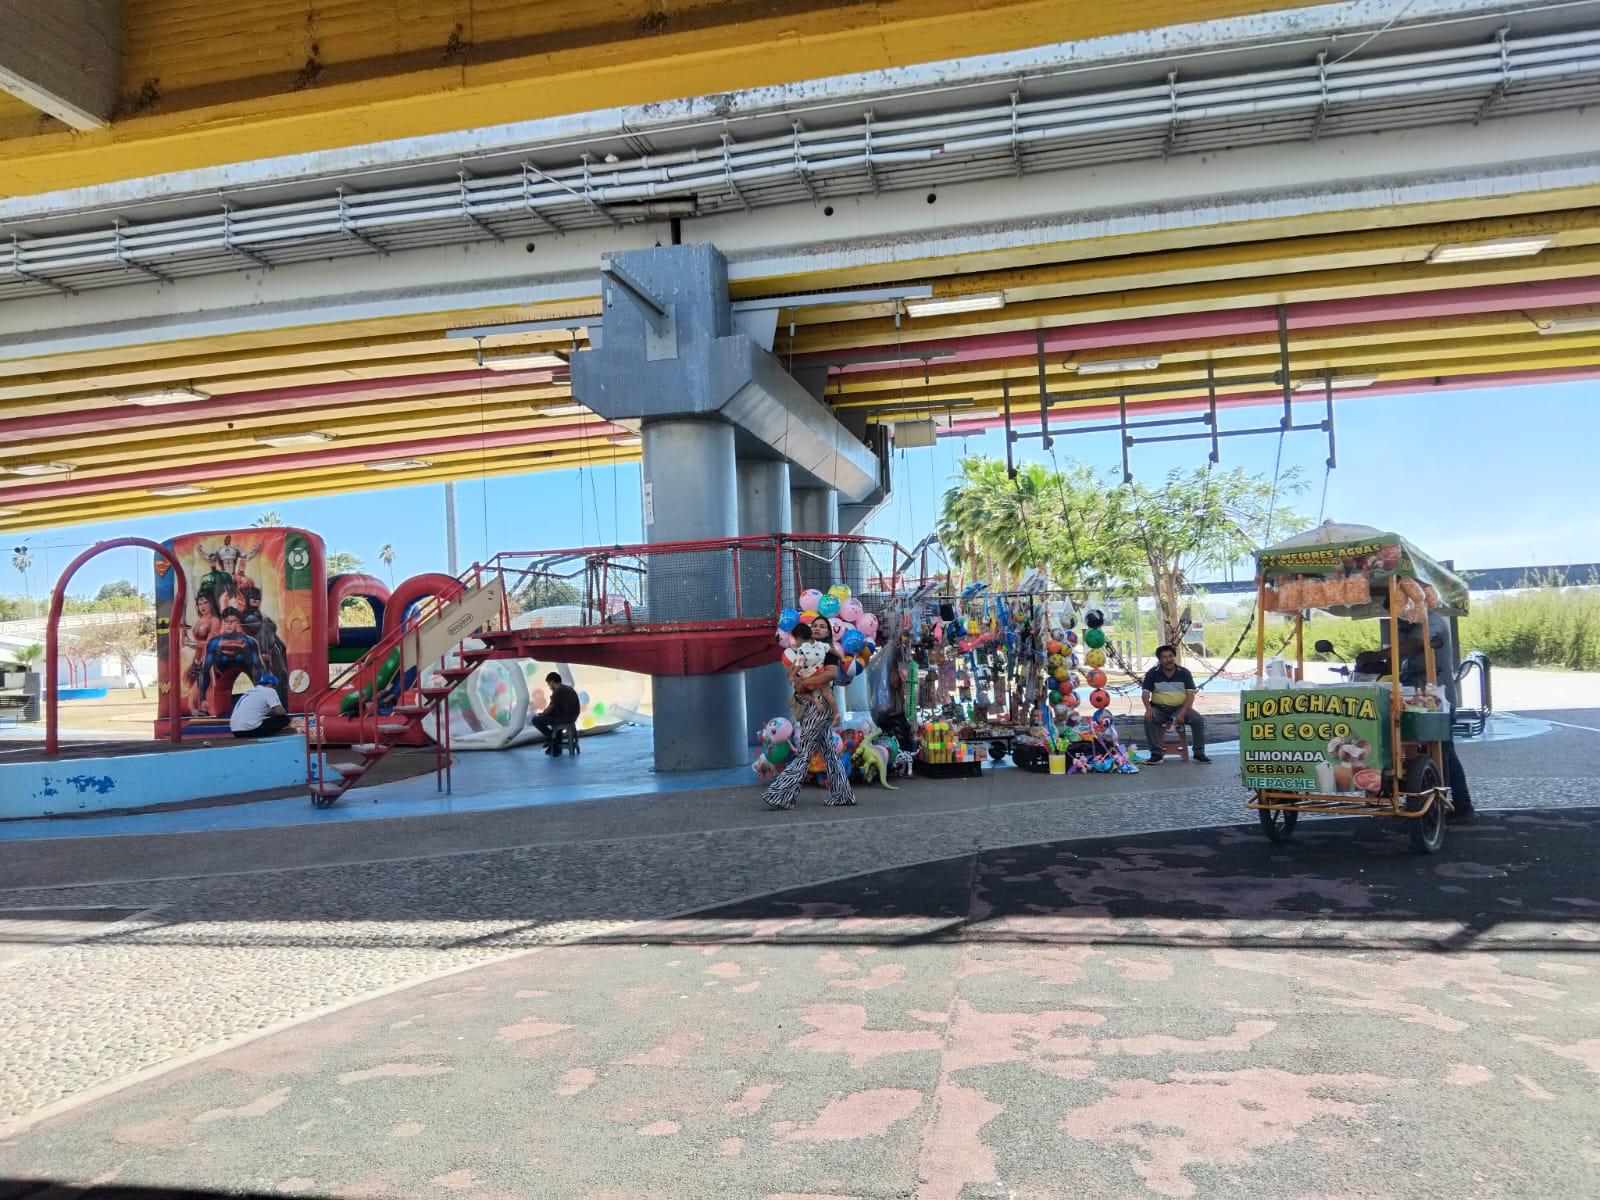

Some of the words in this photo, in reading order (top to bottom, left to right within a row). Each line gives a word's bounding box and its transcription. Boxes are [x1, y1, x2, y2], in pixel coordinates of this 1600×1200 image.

[1338, 543, 1382, 557] AGUAS
[1245, 693, 1377, 721] HORCHATA
[1251, 723, 1276, 740] DE
[1282, 723, 1351, 740] COCO
[1245, 750, 1325, 762] LIMONADA
[1246, 764, 1305, 774] CEBADA
[1246, 777, 1316, 790] TEPACHE
